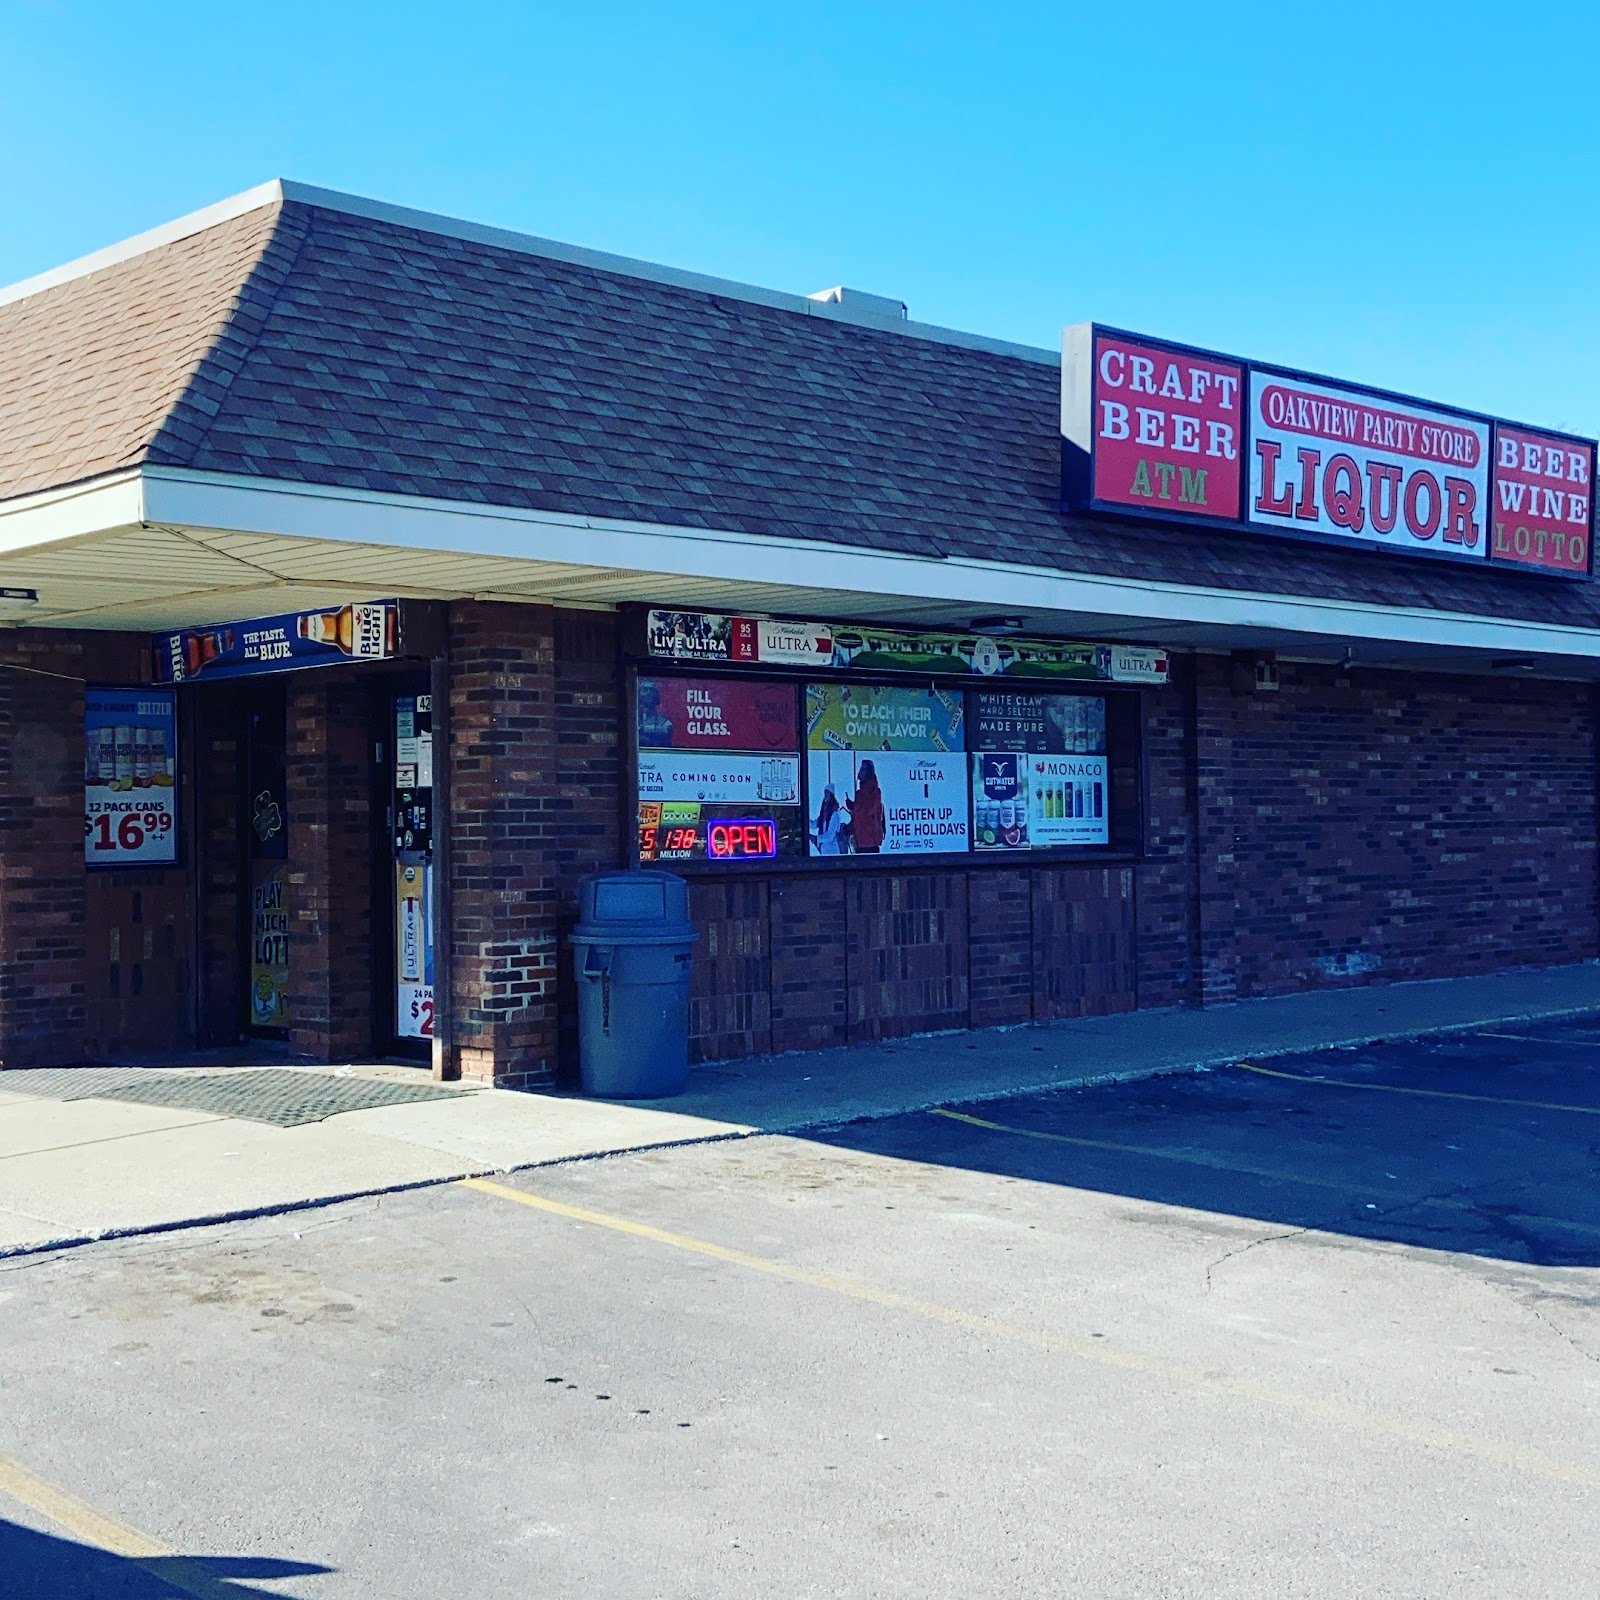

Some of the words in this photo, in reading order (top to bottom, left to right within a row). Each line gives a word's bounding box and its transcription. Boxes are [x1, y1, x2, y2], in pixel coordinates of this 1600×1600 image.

[1099, 350, 1238, 411] CRAFT
[1099, 399, 1238, 461] BEER
[1268, 391, 1357, 440] OAKVIEW
[1362, 412, 1417, 452] PARTY
[1420, 425, 1475, 464] STORE
[1497, 436, 1589, 485] BEER
[1129, 459, 1209, 506] ATM
[1254, 439, 1480, 548] LIQUOR
[1497, 478, 1589, 524] WINE
[1494, 522, 1587, 564] LOTTO
[371, 608, 381, 655] LIGHT
[740, 624, 751, 634] 95
[243, 632, 260, 645] THE
[654, 635, 683, 649] LIVE
[686, 636, 727, 652] ULTRA
[767, 636, 812, 651] ULTRA
[244, 646, 259, 658] ALL
[260, 641, 293, 661] BLUE.
[1119, 658, 1152, 672] ULTRA
[686, 689, 712, 704] FILL
[979, 693, 1012, 706] WHITE
[1015, 695, 1043, 706] CLAW
[137, 702, 172, 715] SELTZER
[686, 705, 722, 720] YOUR
[843, 704, 859, 718] TO
[861, 705, 894, 720] EACH
[897, 706, 932, 721] THEIR
[980, 706, 1004, 715] HARD
[1007, 707, 1043, 717] SELTZER
[687, 721, 731, 736] GLASS.
[846, 721, 877, 736] OWN
[879, 723, 927, 738] FLAVOR
[979, 721, 1011, 732] MADE
[1016, 721, 1044, 733] PURE
[909, 769, 945, 781] ULTRA
[1048, 763, 1102, 776] MONACO
[639, 772, 664, 784] TRA
[672, 772, 717, 783] COMING
[722, 774, 752, 783] SOON
[89, 802, 102, 812] 12
[104, 802, 133, 812] PACK
[135, 802, 165, 812] CANS
[889, 807, 935, 821] LIGHTEN
[938, 807, 953, 820] UP
[889, 823, 911, 836] THE
[914, 822, 966, 836] HOLIDAYS
[711, 825, 773, 856] OPEN
[923, 838, 934, 849] 95
[660, 849, 691, 859] MILLION
[255, 881, 283, 910] PLAY
[255, 914, 289, 936] MICH
[255, 935, 289, 966] LOTT
[406, 923, 415, 968] ULTRA
[414, 989, 423, 998] 24
[424, 989, 433, 999] PA
[411, 1000, 434, 1035] $2
